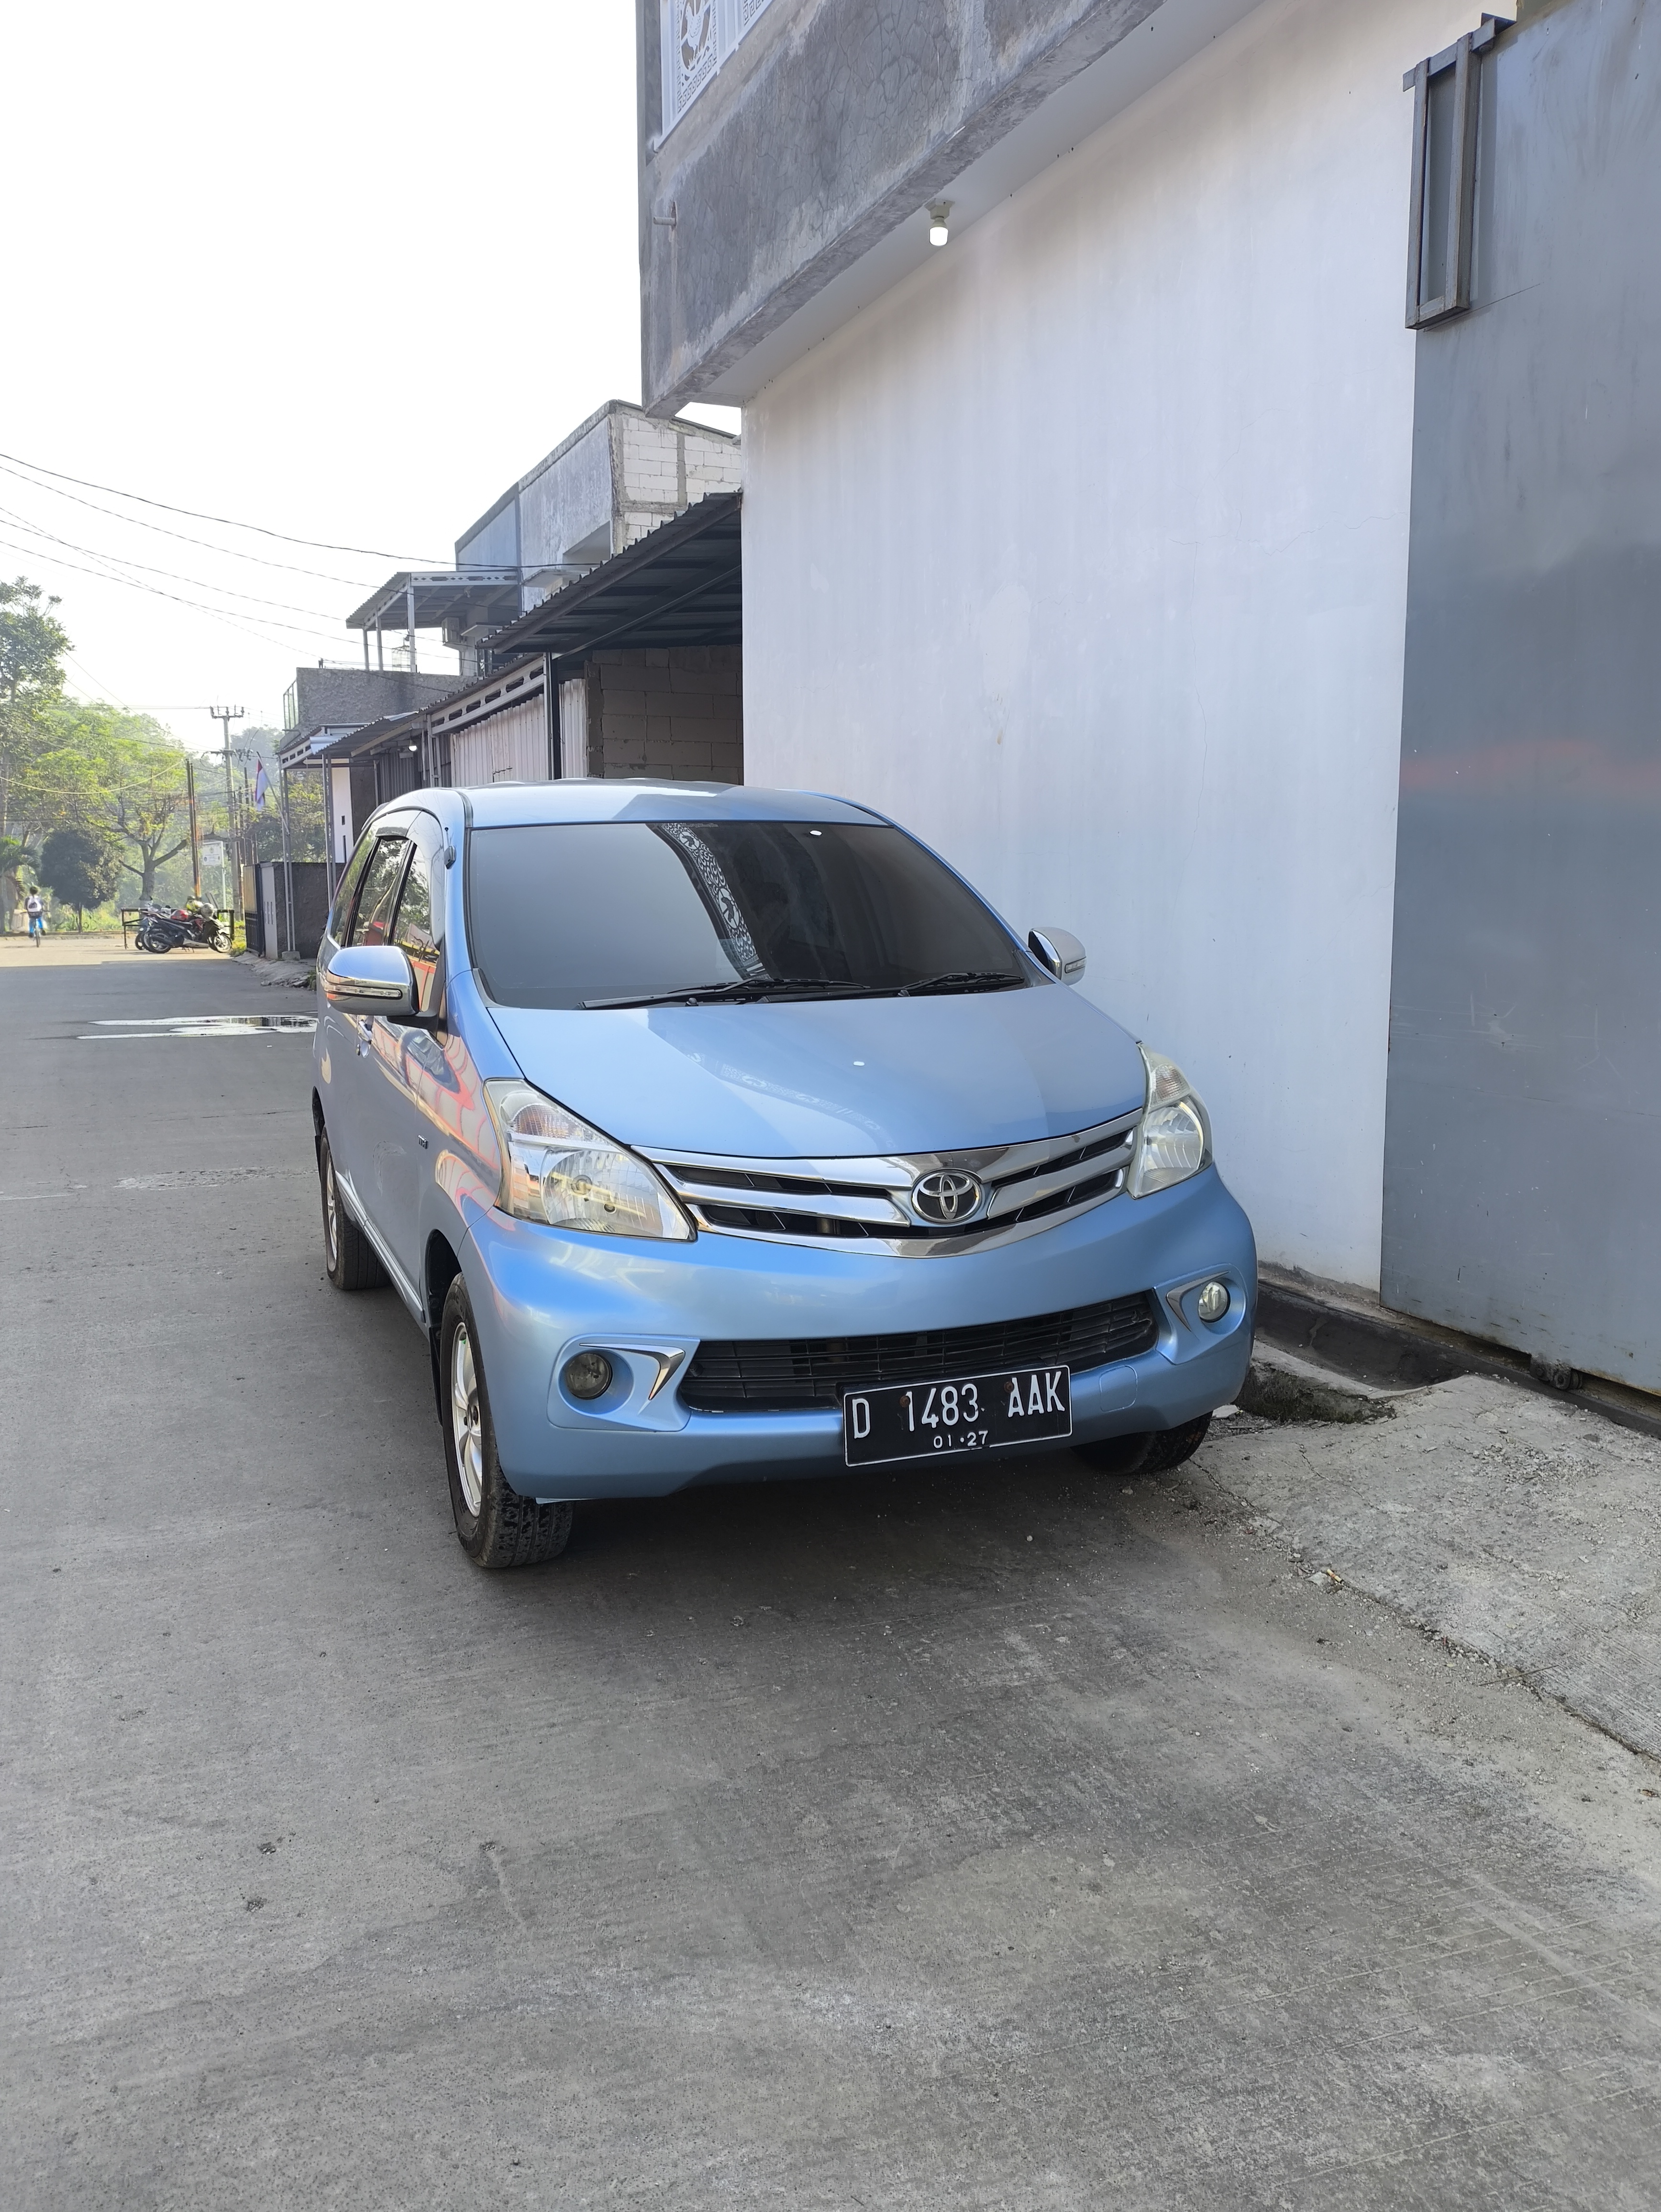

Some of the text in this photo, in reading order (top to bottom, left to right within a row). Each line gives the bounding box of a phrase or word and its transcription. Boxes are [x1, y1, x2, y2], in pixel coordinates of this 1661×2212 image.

[852, 1371, 1065, 1439] D 1483 AAK
